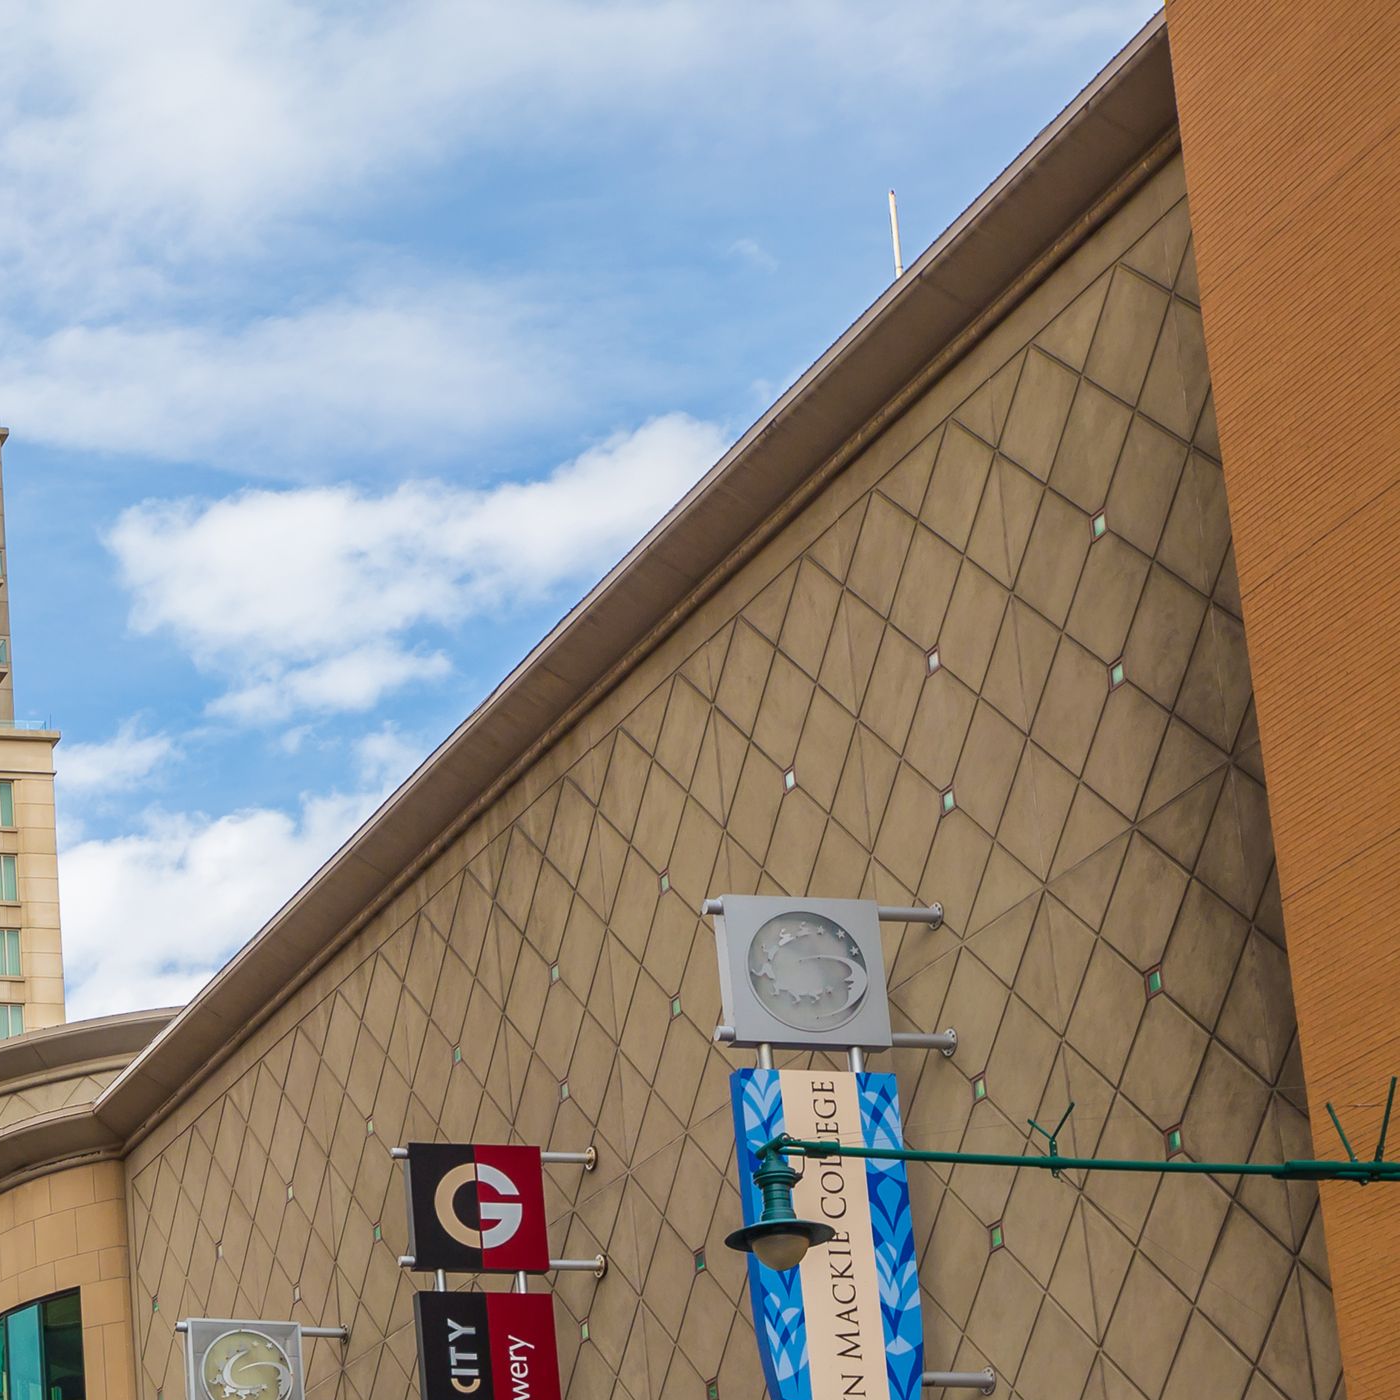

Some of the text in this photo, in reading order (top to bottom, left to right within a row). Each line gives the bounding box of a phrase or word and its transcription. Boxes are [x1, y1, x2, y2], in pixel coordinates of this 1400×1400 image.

[812, 1081, 847, 1219] COLEGE
[447, 1318, 481, 1393] CITY
[828, 1231, 863, 1360] MACKIE
